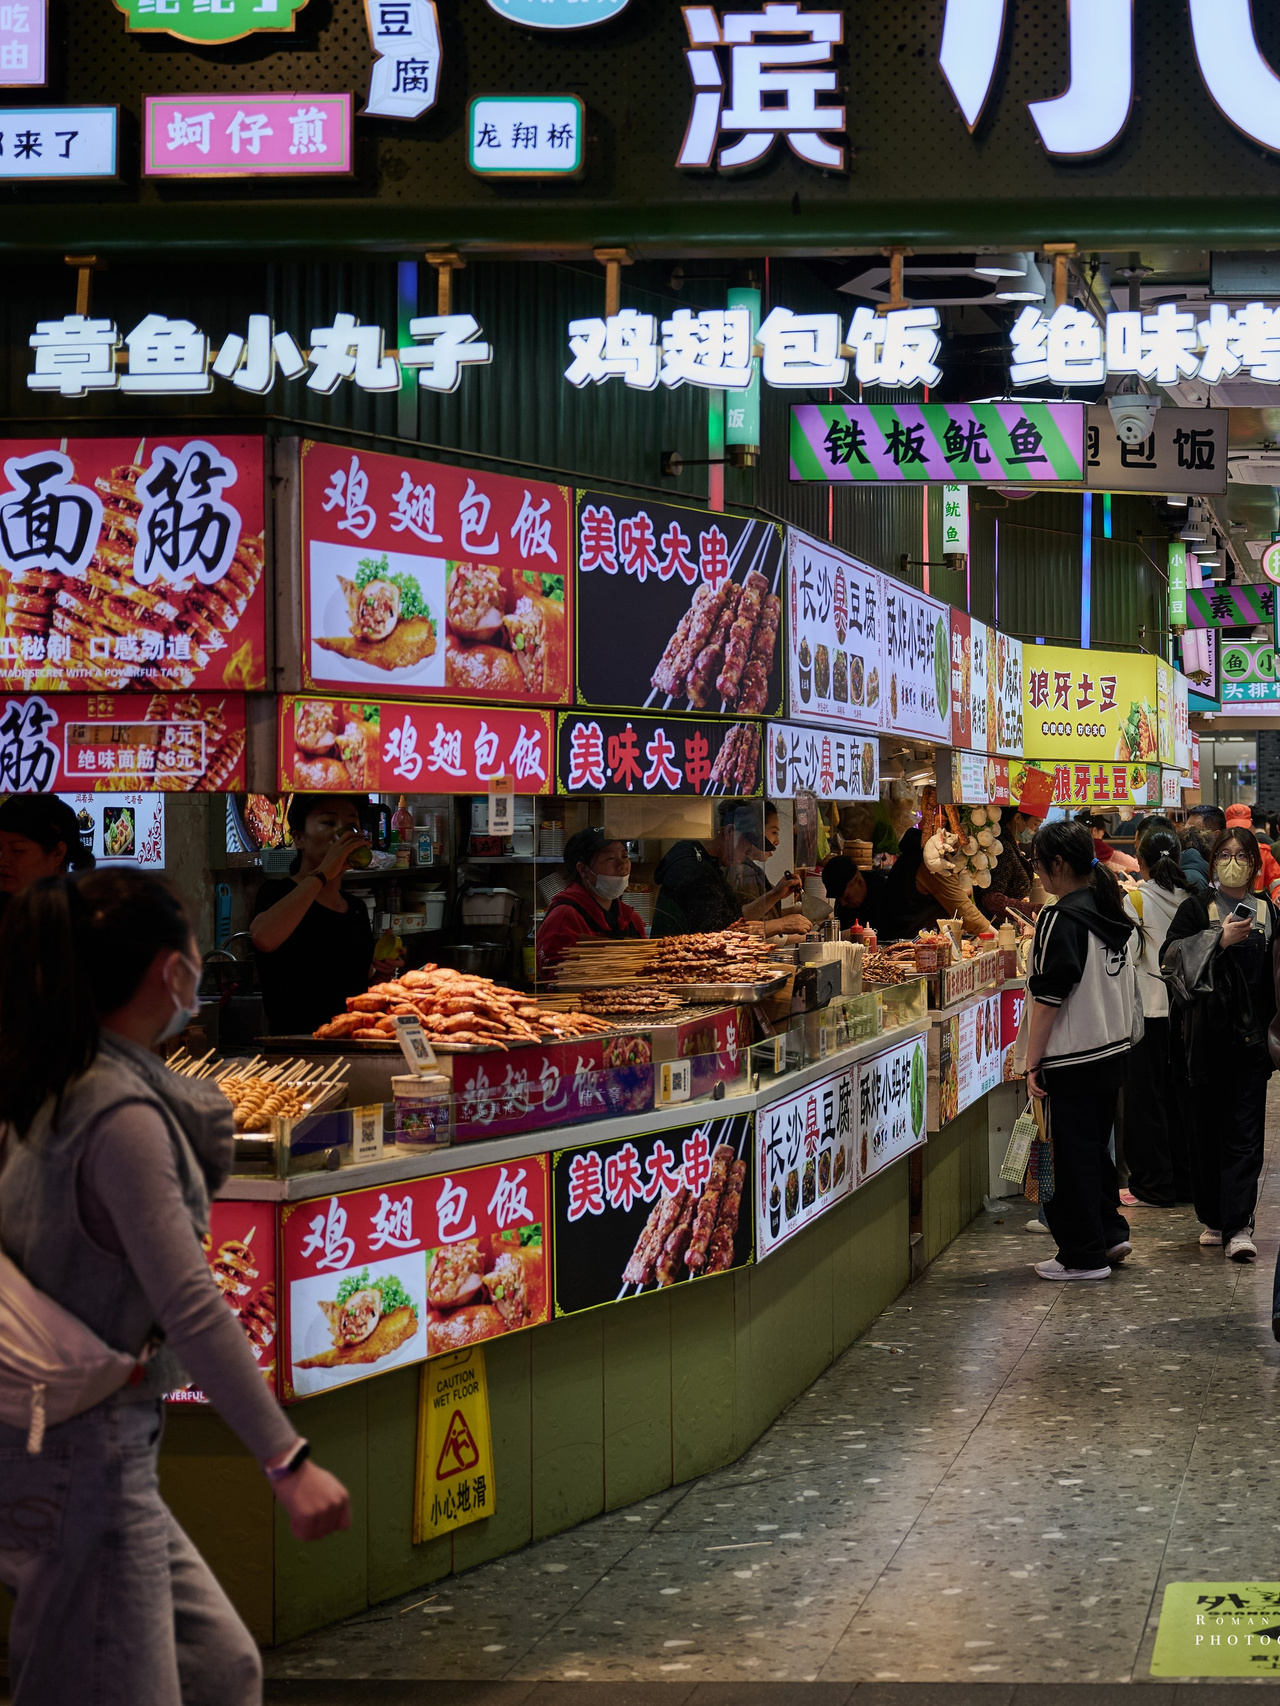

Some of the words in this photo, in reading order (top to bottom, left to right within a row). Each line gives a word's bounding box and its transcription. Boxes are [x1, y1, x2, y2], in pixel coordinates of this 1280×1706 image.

[376, 2, 430, 94] 豆腐
[677, 3, 845, 170] 滨
[167, 108, 328, 155] 蚵仔煎
[475, 122, 575, 151] 龙翔桥
[28, 313, 493, 396] 章鱼小丸子
[564, 307, 943, 391] 鸡翅包饭
[822, 417, 1048, 466] 铁板鱿鱼
[0, 449, 234, 577] 面筋
[323, 455, 560, 564] 鸡翅包饭
[579, 505, 731, 591] 美味大串
[799, 556, 877, 643] 长沙臭豆腐
[1170, 553, 1184, 614] 小土豆
[29, 668, 64, 678] SECRET
[66, 668, 93, 678] WITH
[105, 668, 158, 678] POWERFUL
[90, 635, 192, 661] 口感劲道
[1028, 667, 1118, 713] 狼牙土豆
[78, 749, 155, 769] 绝味面筋
[165, 750, 195, 769] 6元
[383, 714, 547, 782] 鸡翅包饭
[568, 722, 711, 794] 美味大串
[787, 731, 861, 796] 长沙臭豆腐
[1054, 764, 1129, 804] 狼牙土豆
[464, 1055, 596, 1125] 鸡翅包饭
[767, 1076, 856, 1181] 长沙臭豆腐
[568, 1129, 711, 1222] 美味大串
[301, 1167, 535, 1270] 鸡翅包饭
[433, 1390, 451, 1410] WET
[454, 1381, 479, 1402] FLOOR
[436, 1367, 475, 1393] CAUTION
[430, 1475, 487, 1527] 小心地滑
